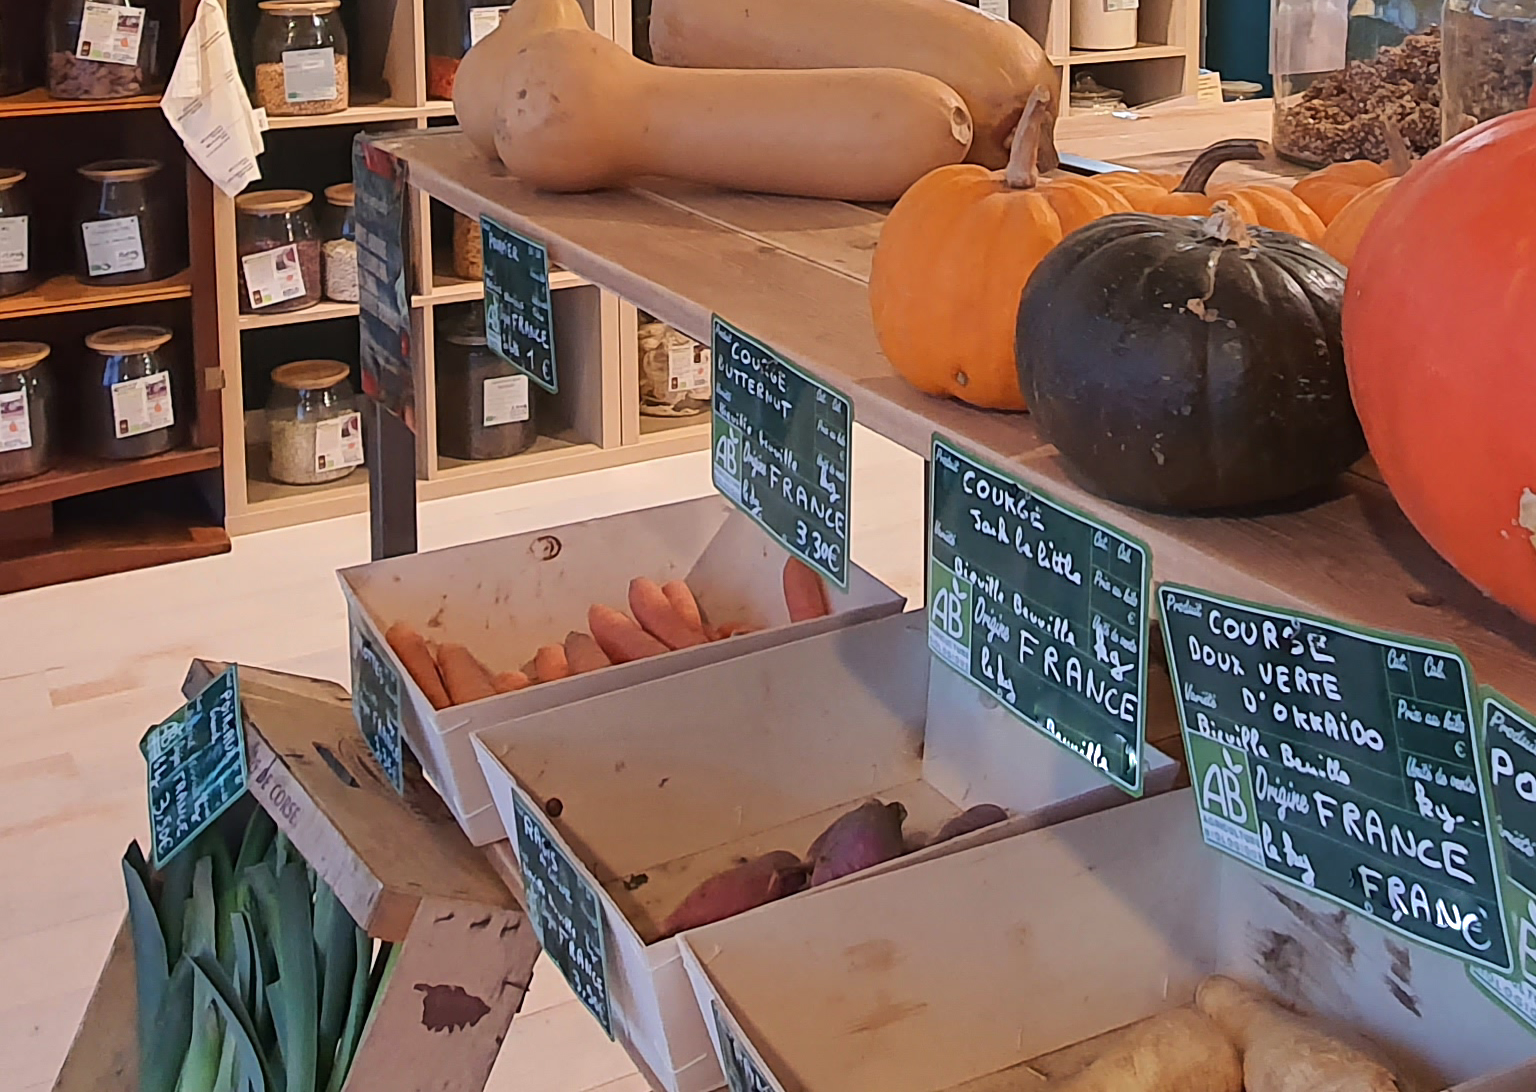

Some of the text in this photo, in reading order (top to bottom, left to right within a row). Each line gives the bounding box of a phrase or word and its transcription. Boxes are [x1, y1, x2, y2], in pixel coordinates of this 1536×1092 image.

[768, 464, 846, 540] FRANCE
[931, 584, 964, 641] AB
[1018, 629, 1139, 724] FRANCE
[1188, 634, 1343, 702] DOUX VERTE
[268, 782, 302, 829] CORSE
[1203, 762, 1477, 887] AB Origine FRANCE
